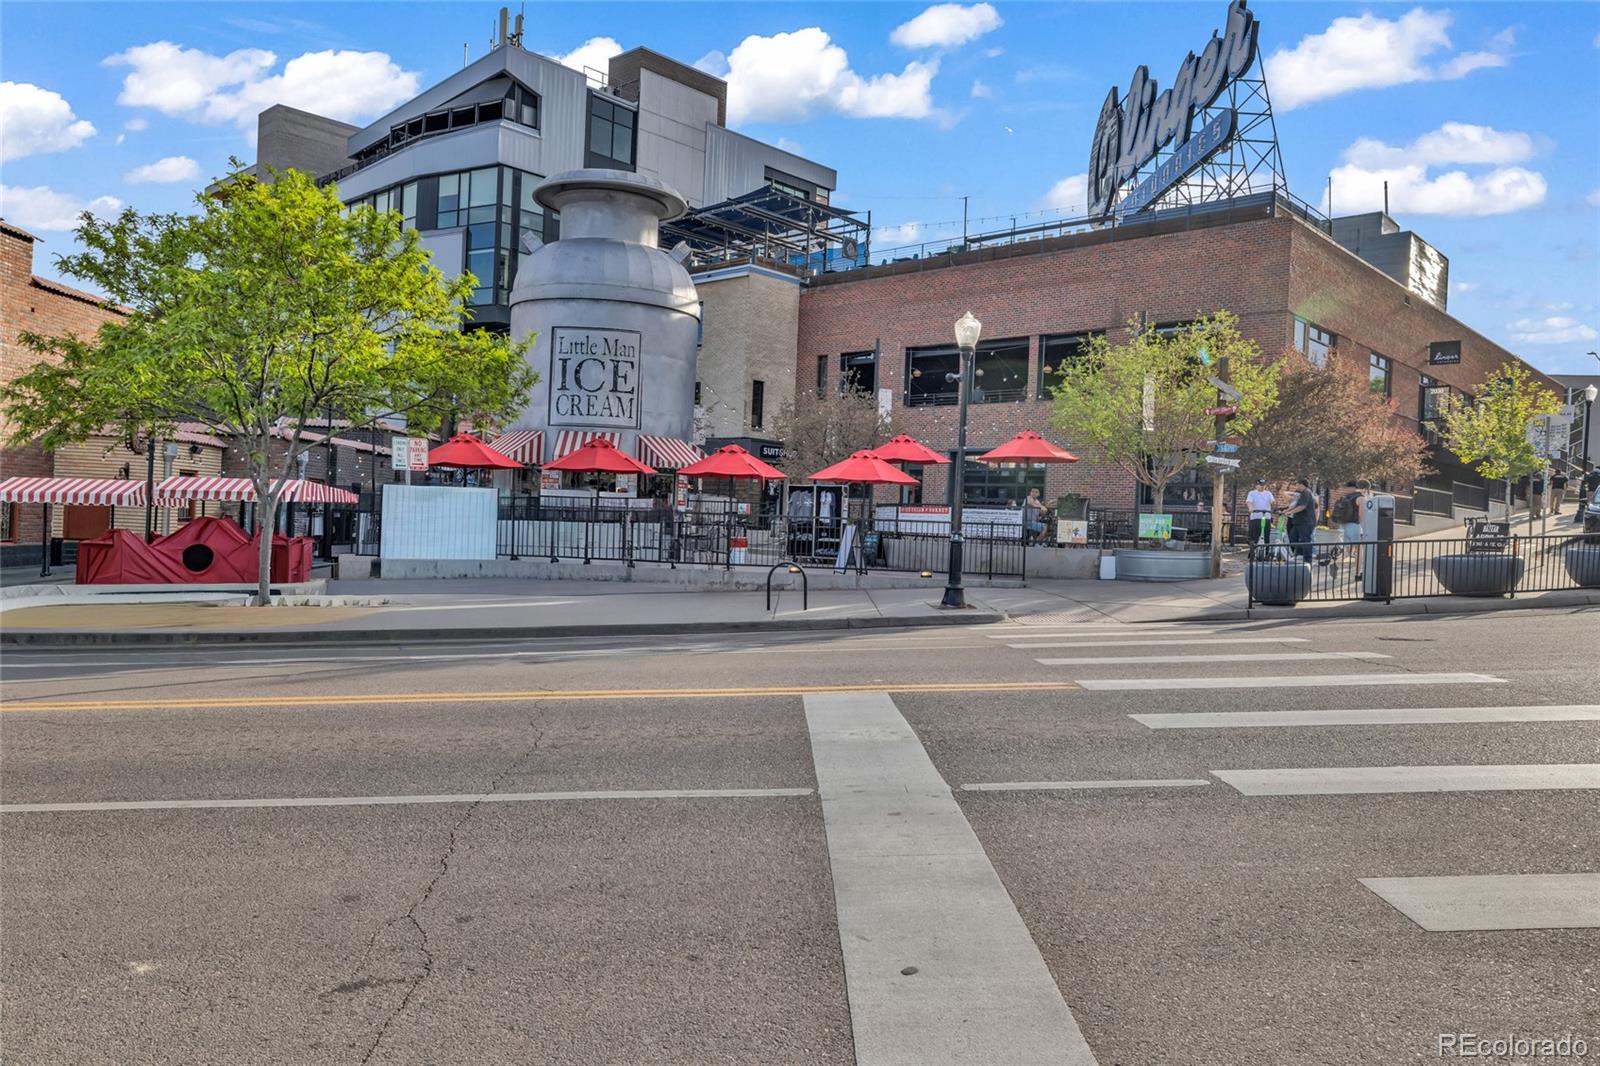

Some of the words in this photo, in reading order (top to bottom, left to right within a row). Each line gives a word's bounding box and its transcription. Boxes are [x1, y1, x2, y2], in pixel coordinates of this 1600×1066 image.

[558, 335, 598, 355] Little
[602, 337, 635, 358] Man
[557, 357, 635, 394] ICE
[555, 394, 635, 419] CREAM
